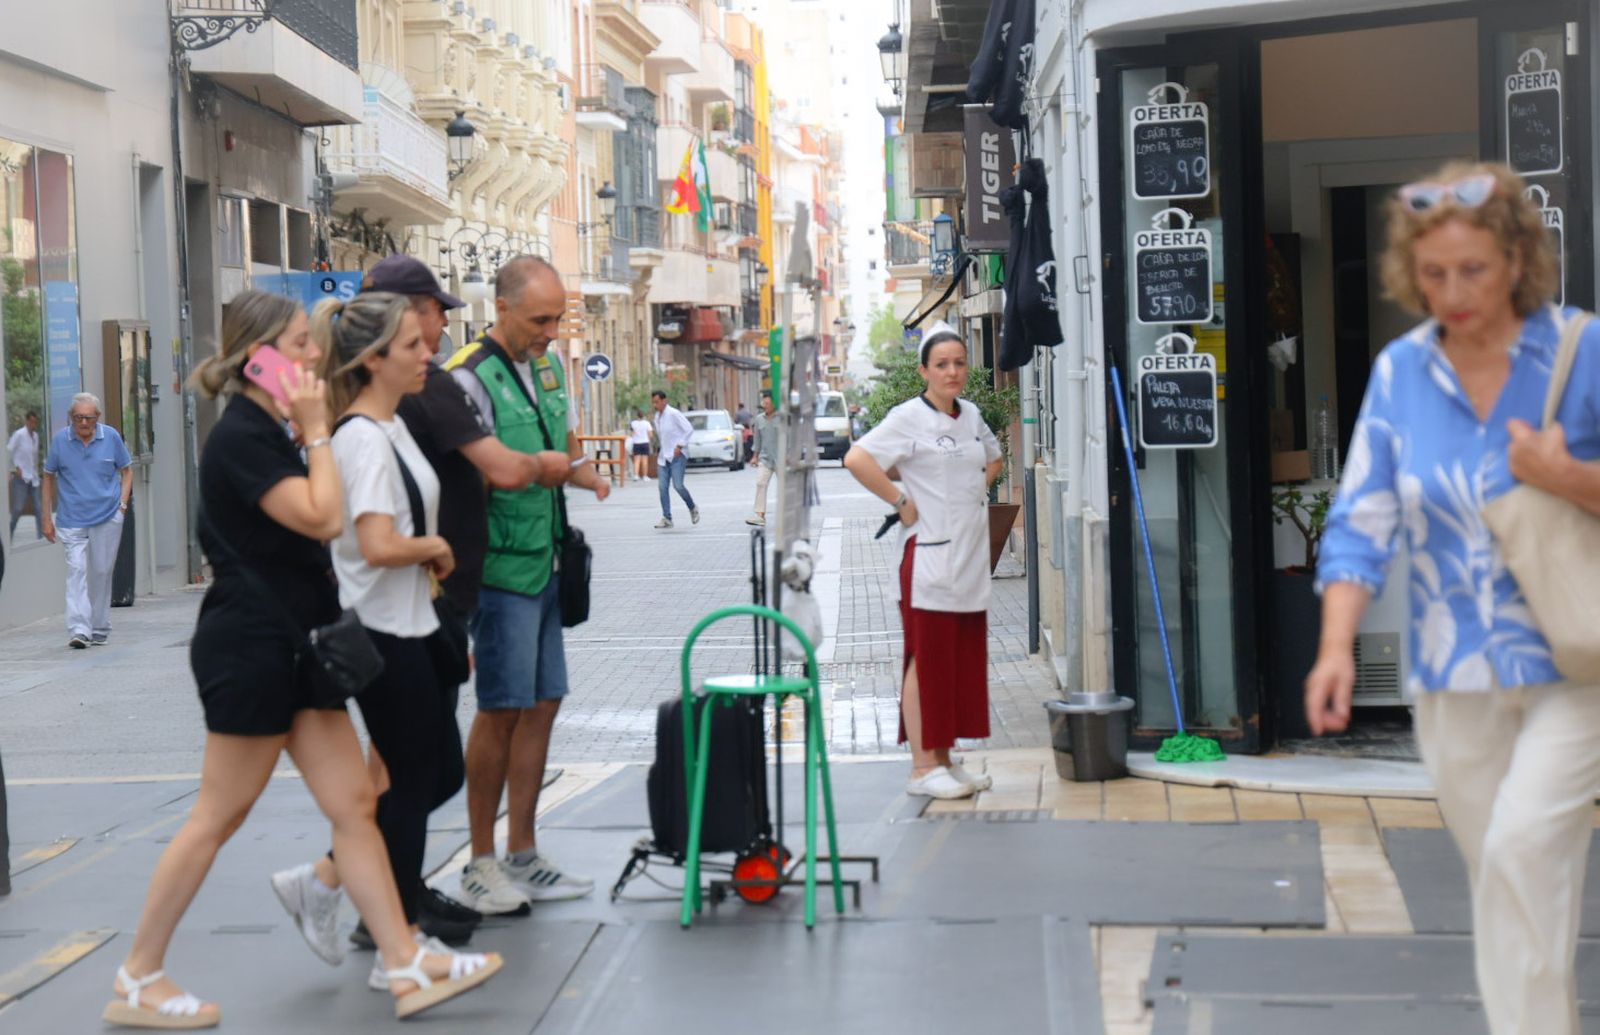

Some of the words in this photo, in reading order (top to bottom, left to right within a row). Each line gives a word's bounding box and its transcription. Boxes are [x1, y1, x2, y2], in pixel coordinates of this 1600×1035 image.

[1508, 71, 1558, 91] OFERTA
[1134, 105, 1204, 121] OFERTA
[1170, 127, 1183, 138] DE
[981, 131, 1000, 224] TIGER
[1137, 231, 1207, 247] OFERTA
[1184, 267, 1197, 278] DE
[1150, 294, 1197, 317] 57,90
[1142, 356, 1211, 370] OFERTA
